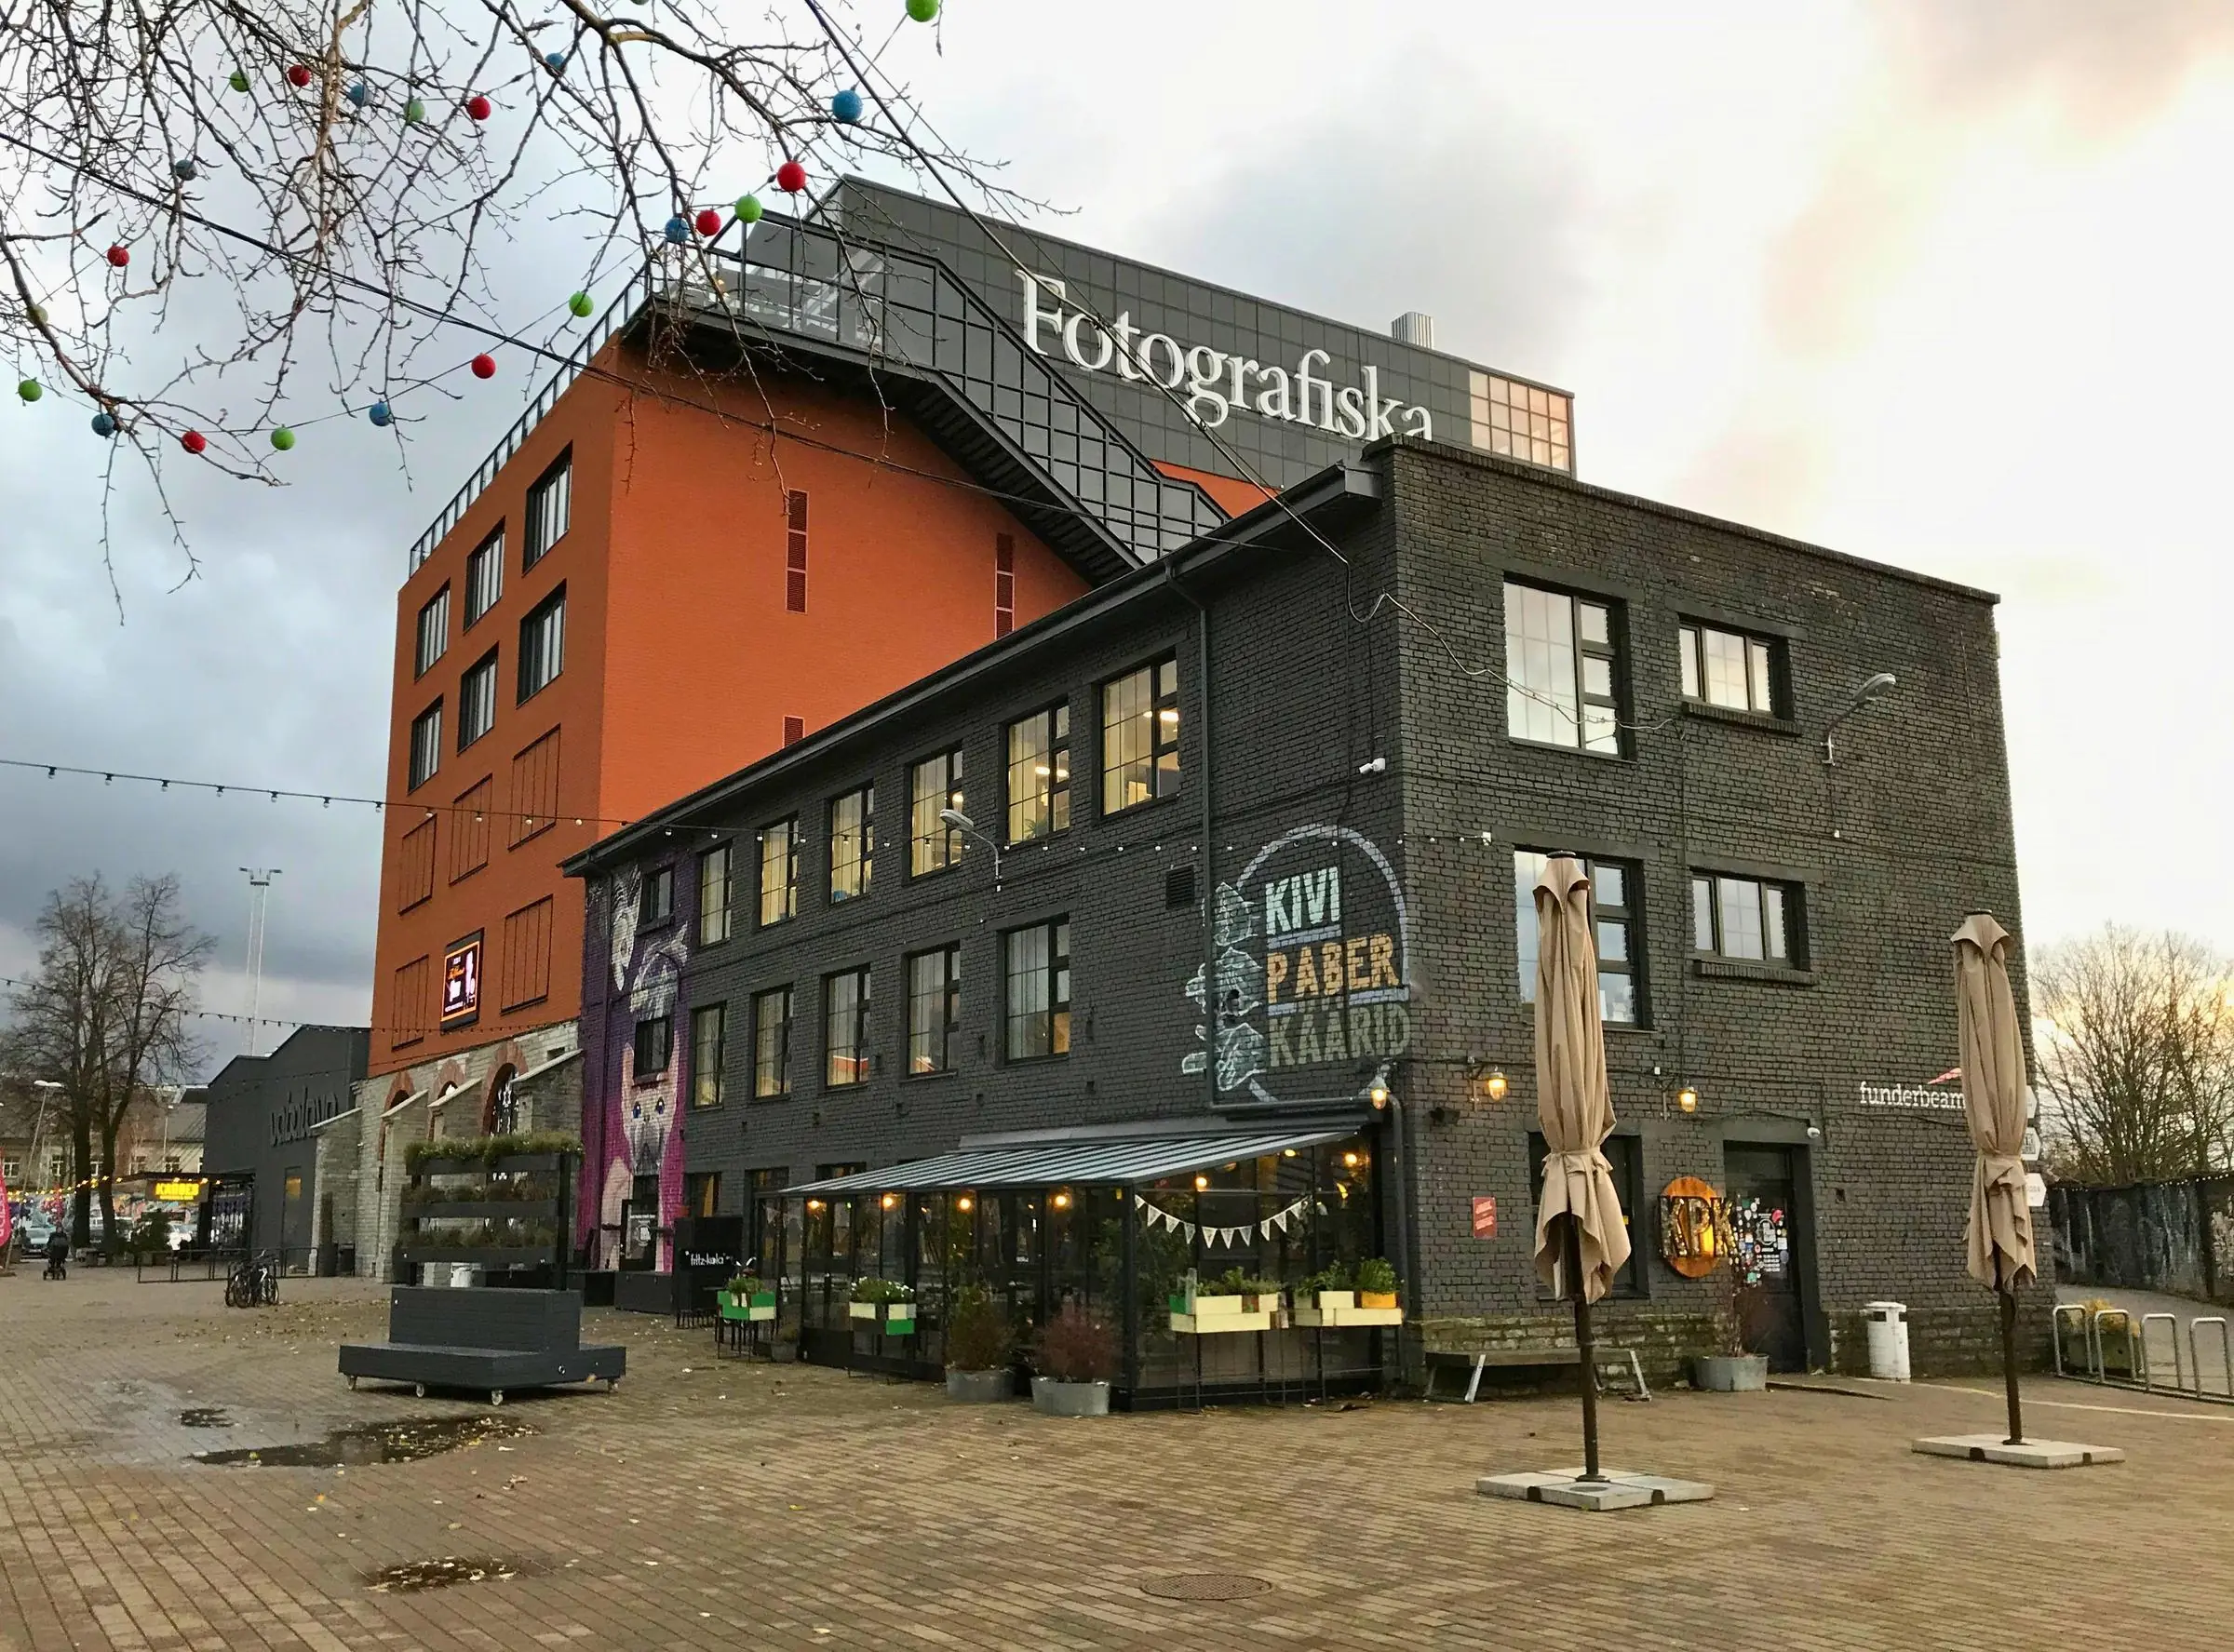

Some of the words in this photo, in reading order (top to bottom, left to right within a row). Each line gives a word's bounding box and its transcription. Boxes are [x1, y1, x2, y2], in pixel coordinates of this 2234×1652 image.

[1015, 269, 1432, 441] Fotografiska
[1266, 866, 1340, 933] KIVI
[1267, 933, 1399, 1003] PABER
[1860, 1081, 1966, 1109] funderbeam
[1659, 1195, 1736, 1257] KPK
